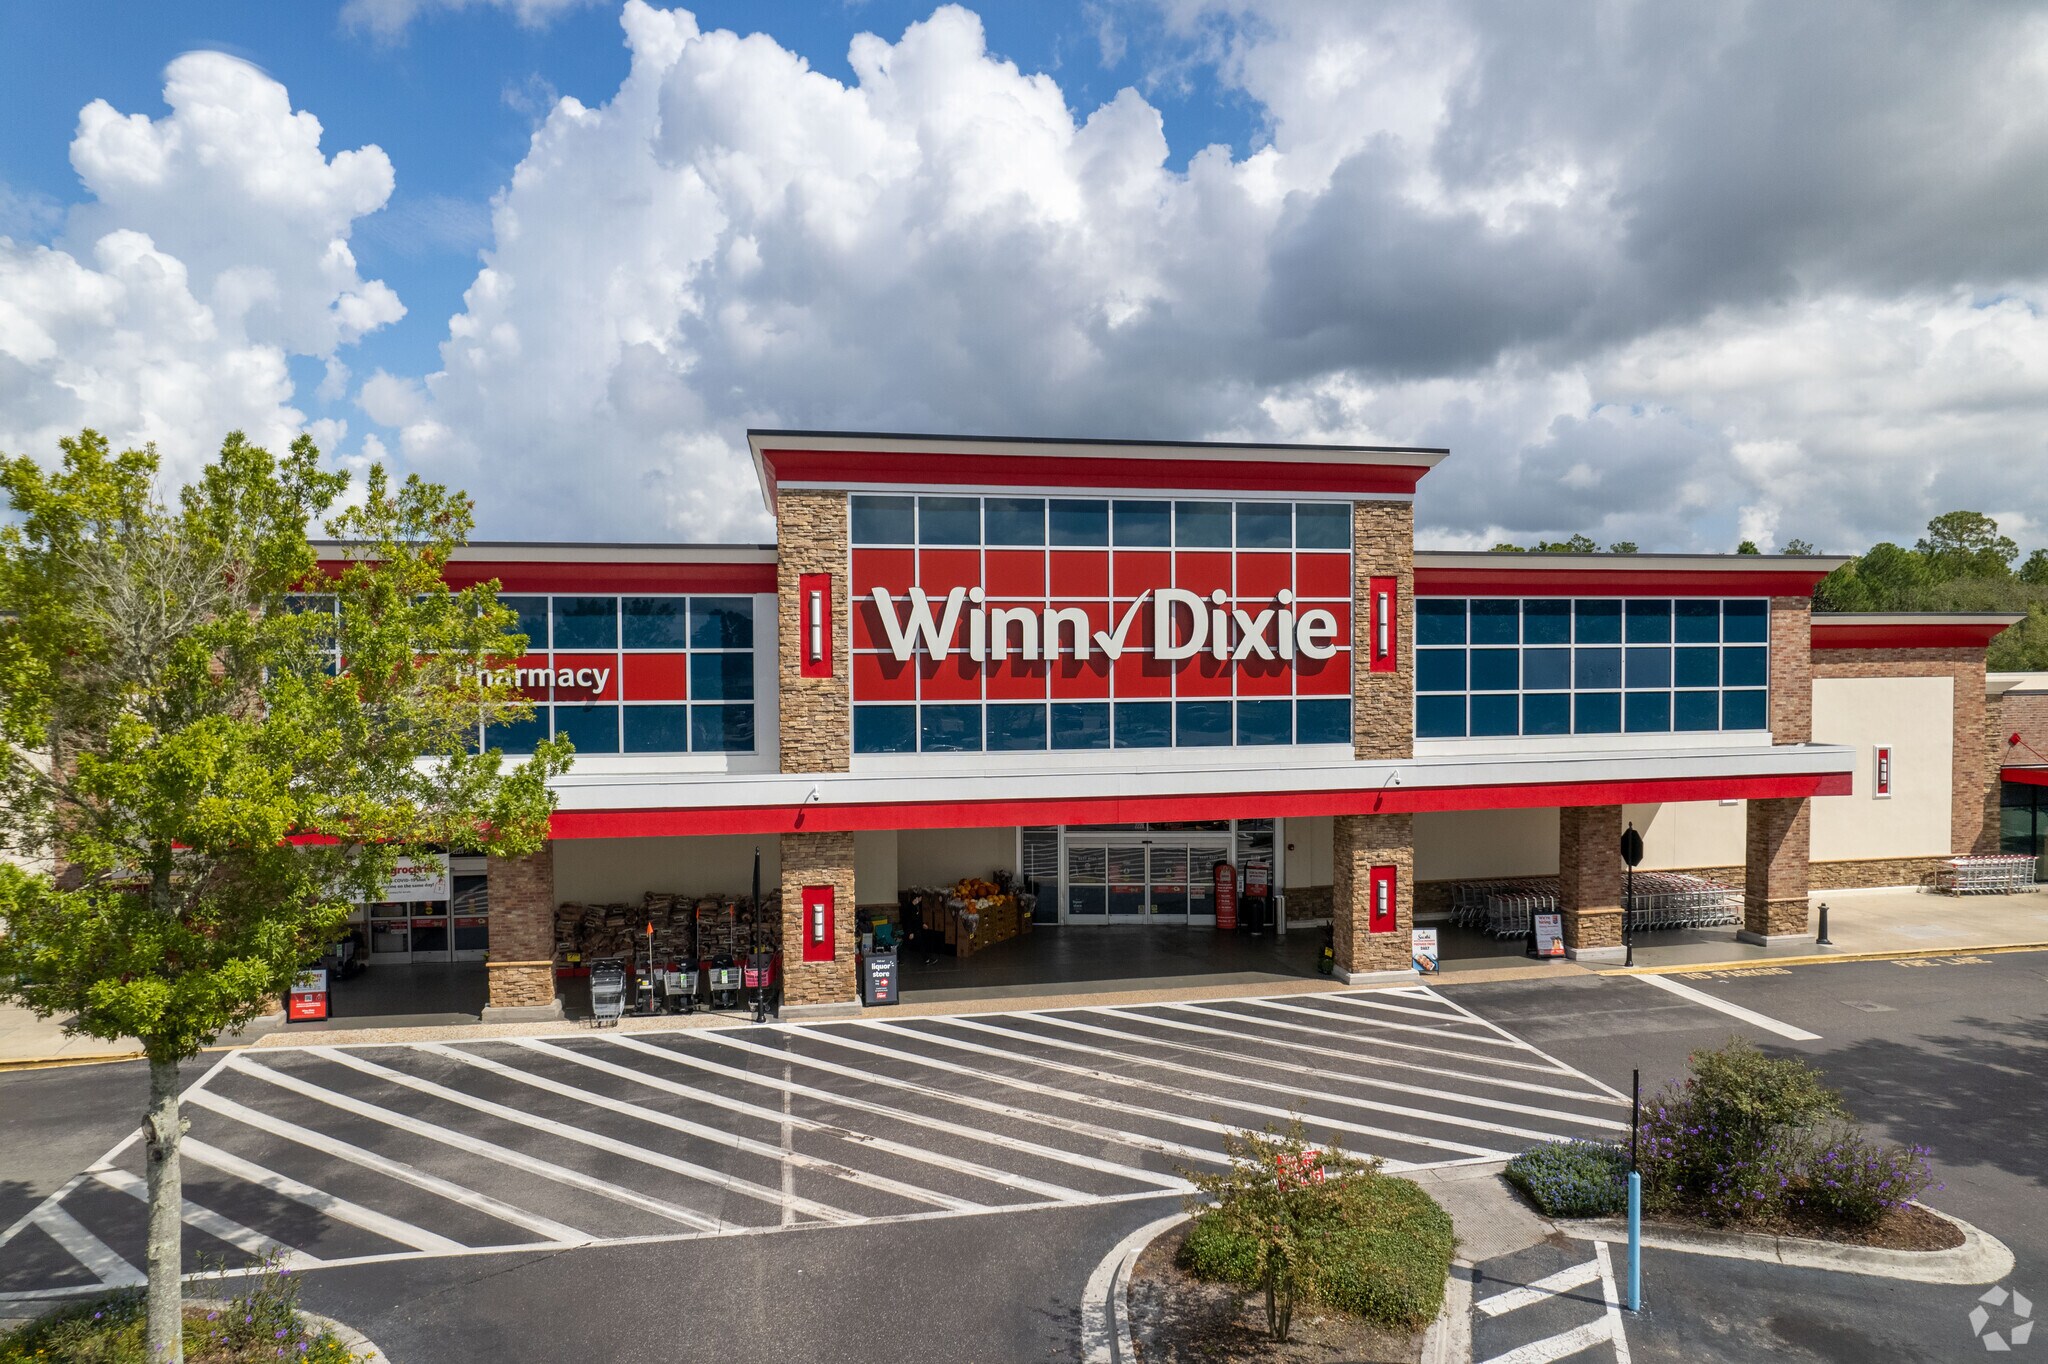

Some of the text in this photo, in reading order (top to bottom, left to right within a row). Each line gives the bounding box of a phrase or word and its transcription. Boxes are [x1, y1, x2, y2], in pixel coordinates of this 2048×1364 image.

[871, 587, 1338, 662] Winn Dixie
[871, 962, 891, 971] liquor
[1680, 967, 1793, 980] NO PARKING
